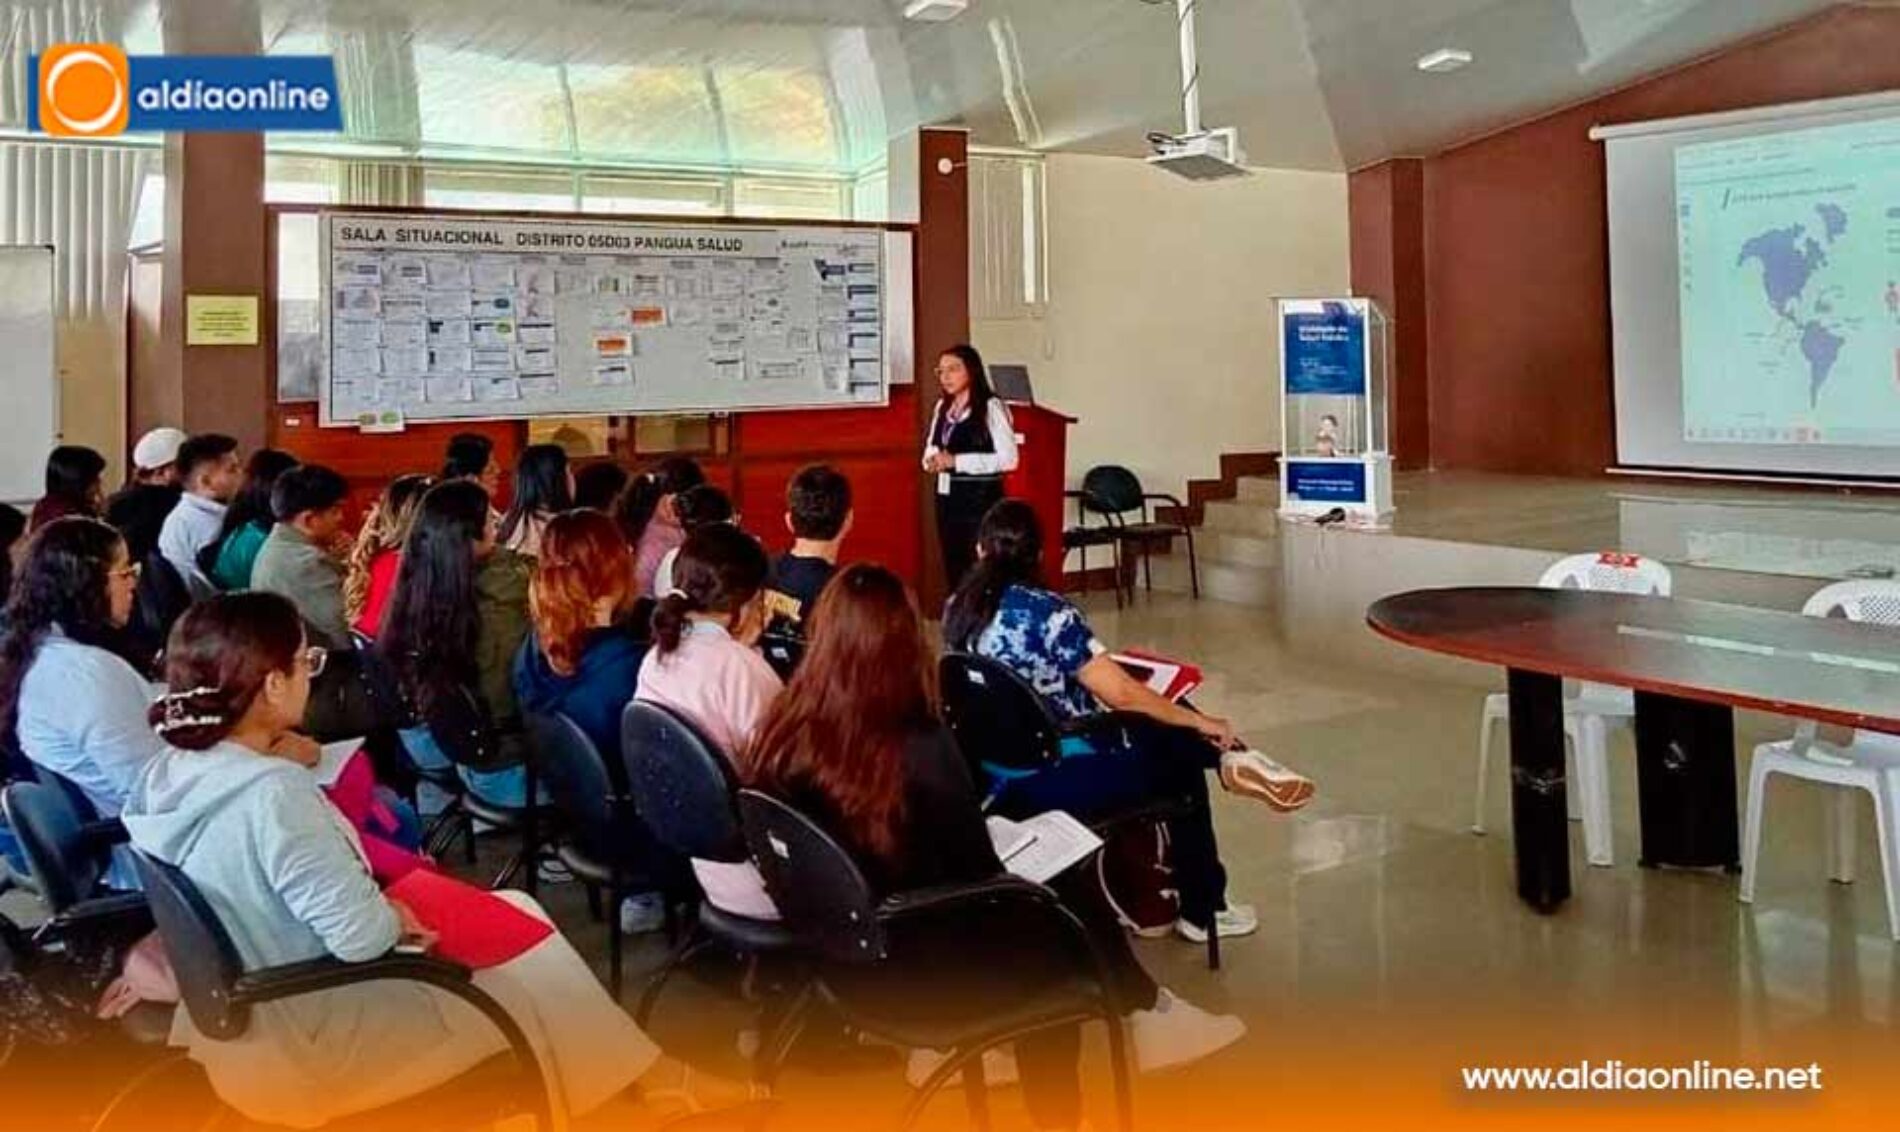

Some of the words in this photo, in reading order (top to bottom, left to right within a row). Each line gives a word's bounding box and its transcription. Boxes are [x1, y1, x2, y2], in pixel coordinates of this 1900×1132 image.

[341, 227, 386, 242] SALA
[395, 229, 503, 245] SITUACIONAL
[516, 233, 585, 247] DISTRITO
[634, 236, 693, 250] PANGUA
[697, 238, 743, 252] SALUD
